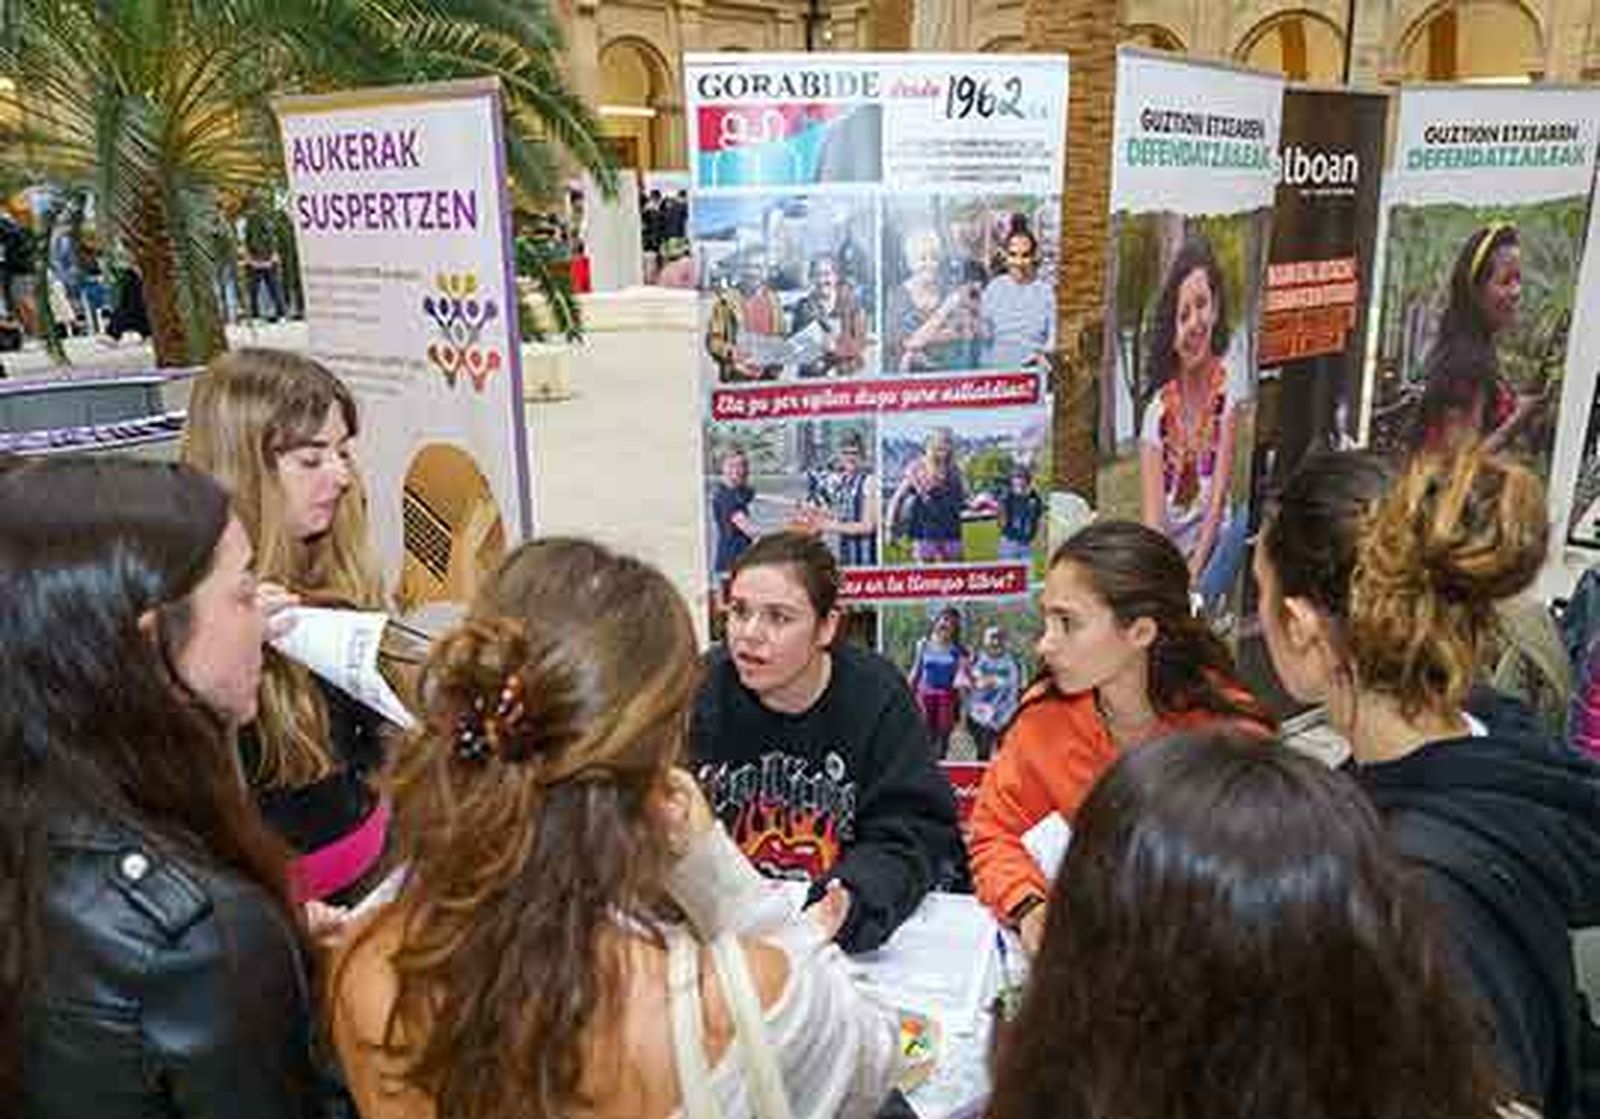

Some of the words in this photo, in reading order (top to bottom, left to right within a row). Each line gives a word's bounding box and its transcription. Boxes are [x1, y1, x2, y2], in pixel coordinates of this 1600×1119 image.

[697, 70, 880, 99] GORABIDE
[946, 74, 1025, 119] 1962
[292, 129, 420, 173] AUKERAK
[1281, 146, 1359, 185] lboan
[297, 188, 477, 230] SUSPERTZEN
